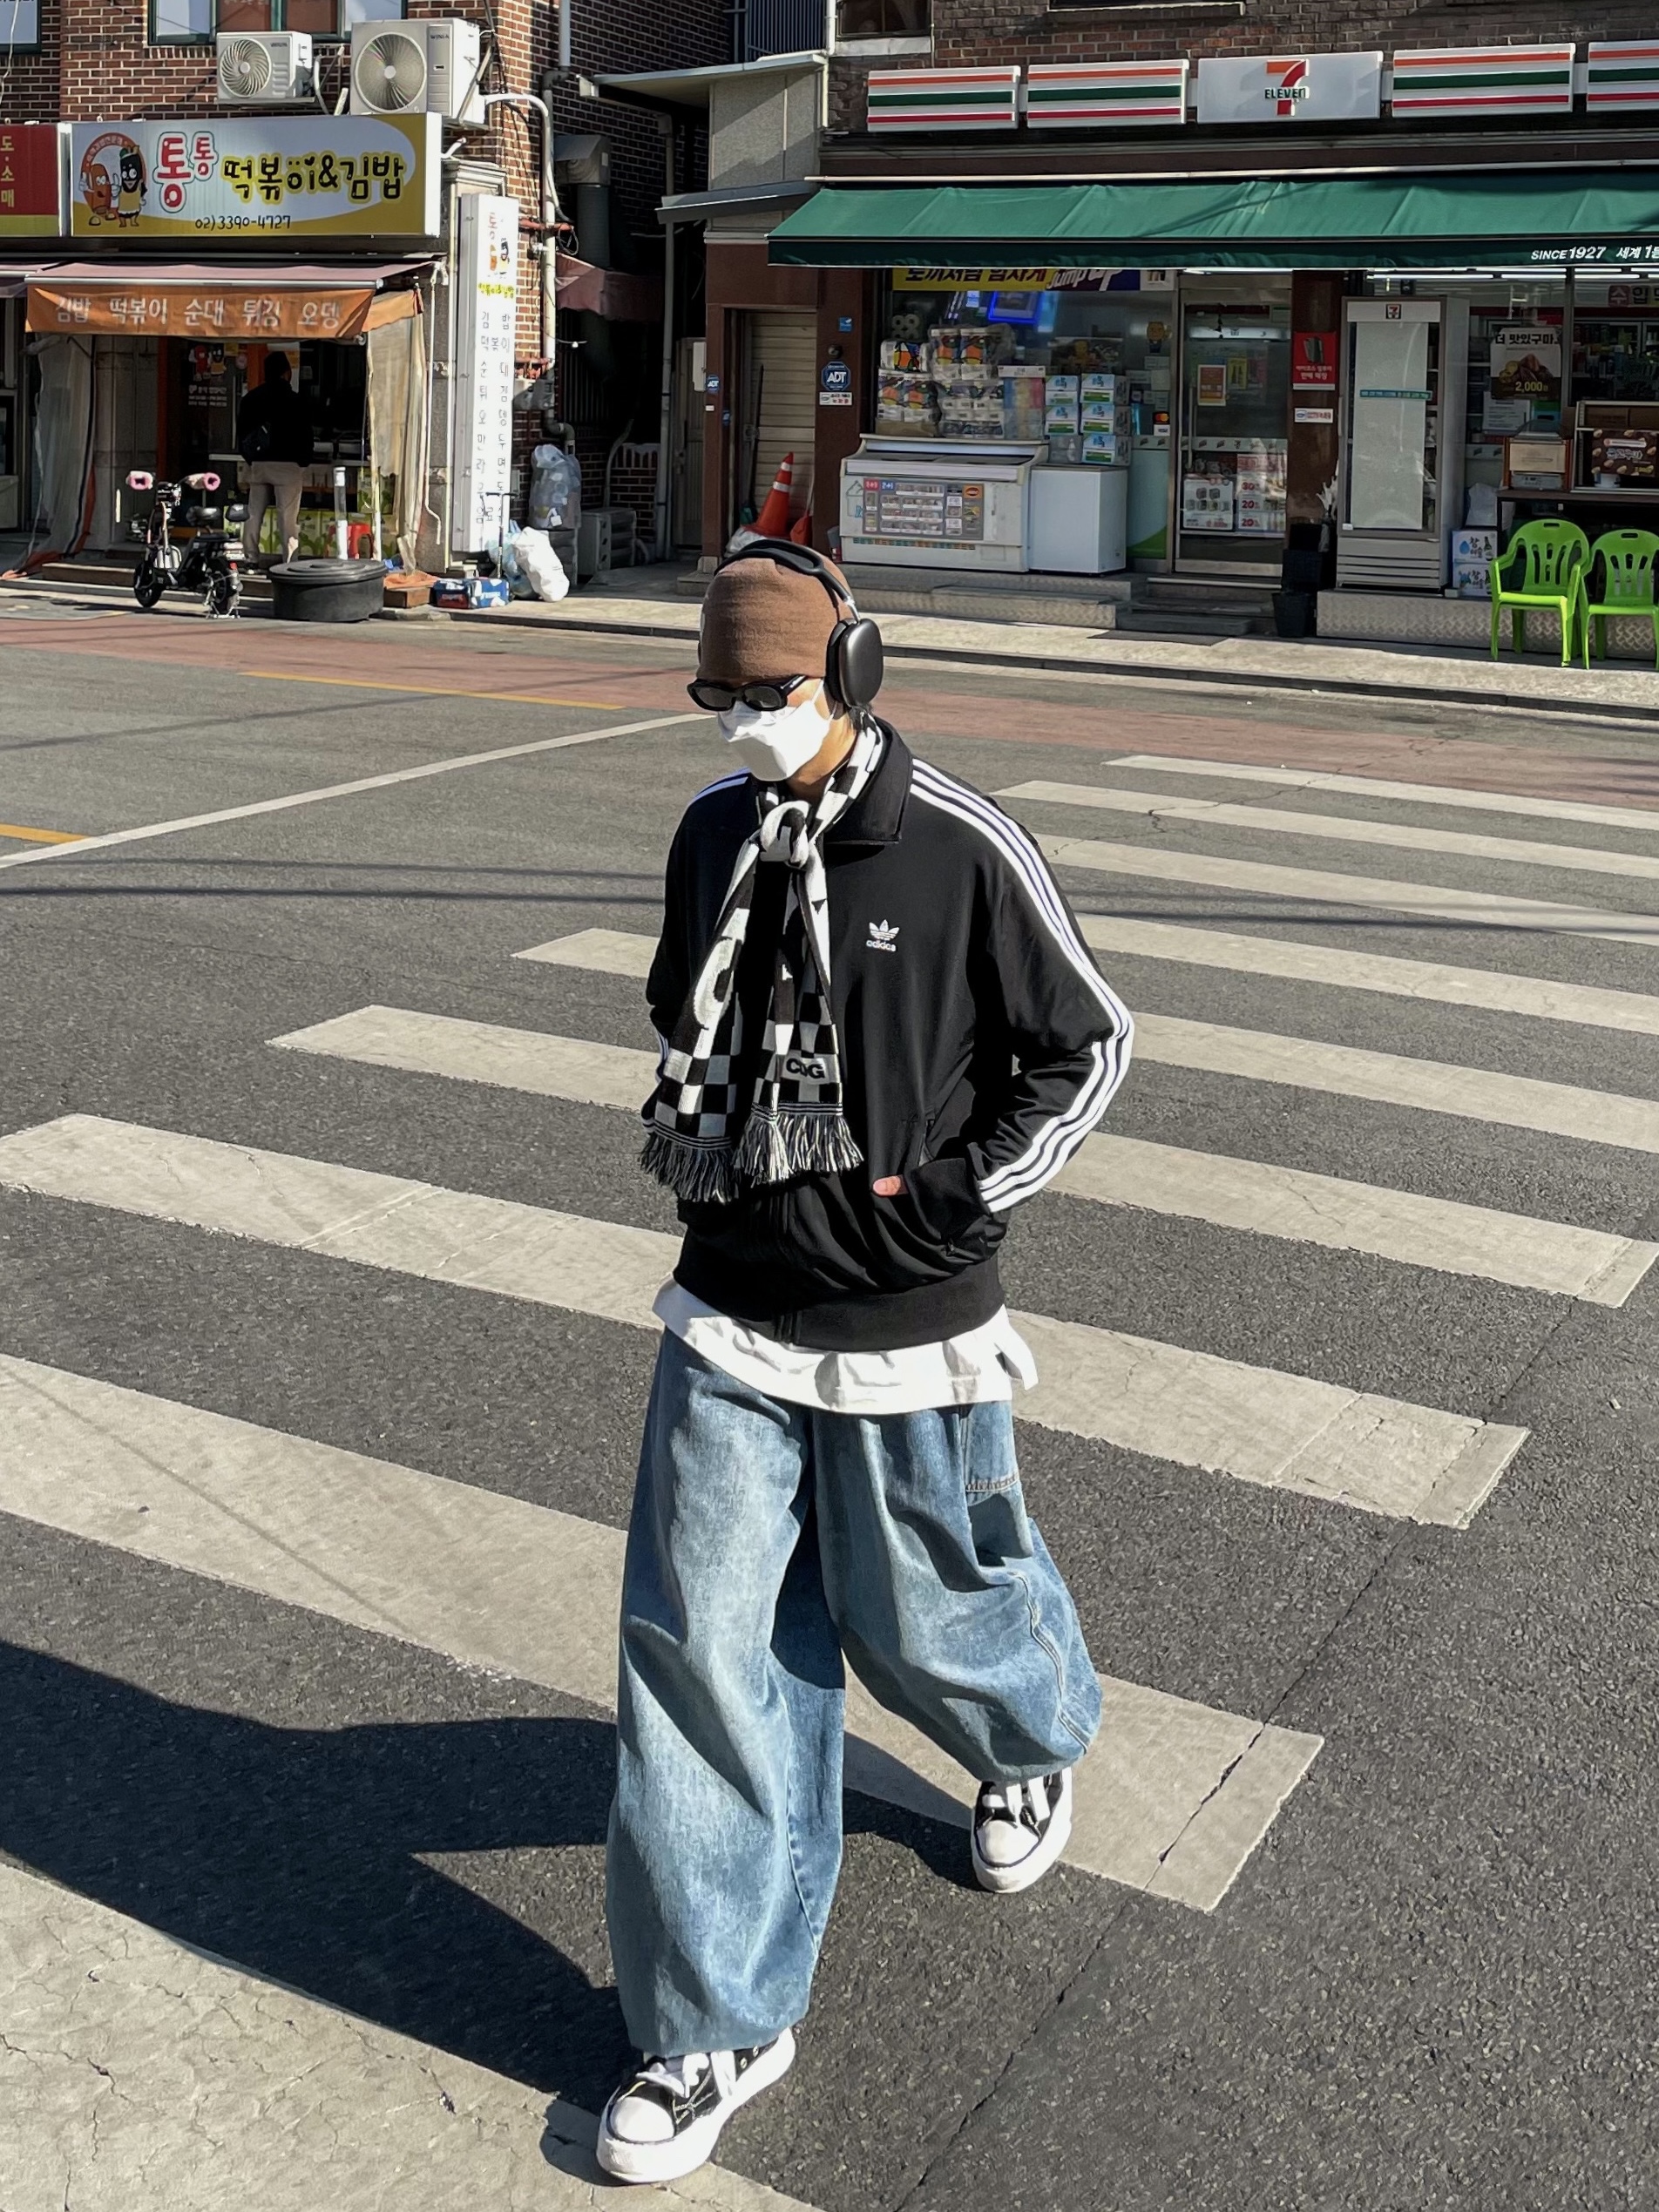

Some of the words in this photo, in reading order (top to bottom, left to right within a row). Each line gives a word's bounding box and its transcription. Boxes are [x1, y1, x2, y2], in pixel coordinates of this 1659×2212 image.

[194, 213, 291, 232] 02)3390-4727
[1531, 249, 1568, 260] SINCE
[1568, 246, 1607, 260] 1927
[1615, 246, 1642, 260] 세계
[55, 295, 91, 324] 김밥
[109, 297, 168, 326] 떡볶이
[184, 299, 225, 327] 순대
[241, 299, 281, 328] 튀김
[297, 301, 342, 330] 오뎅
[826, 371, 847, 383] ADT
[865, 939, 897, 952] adidas
